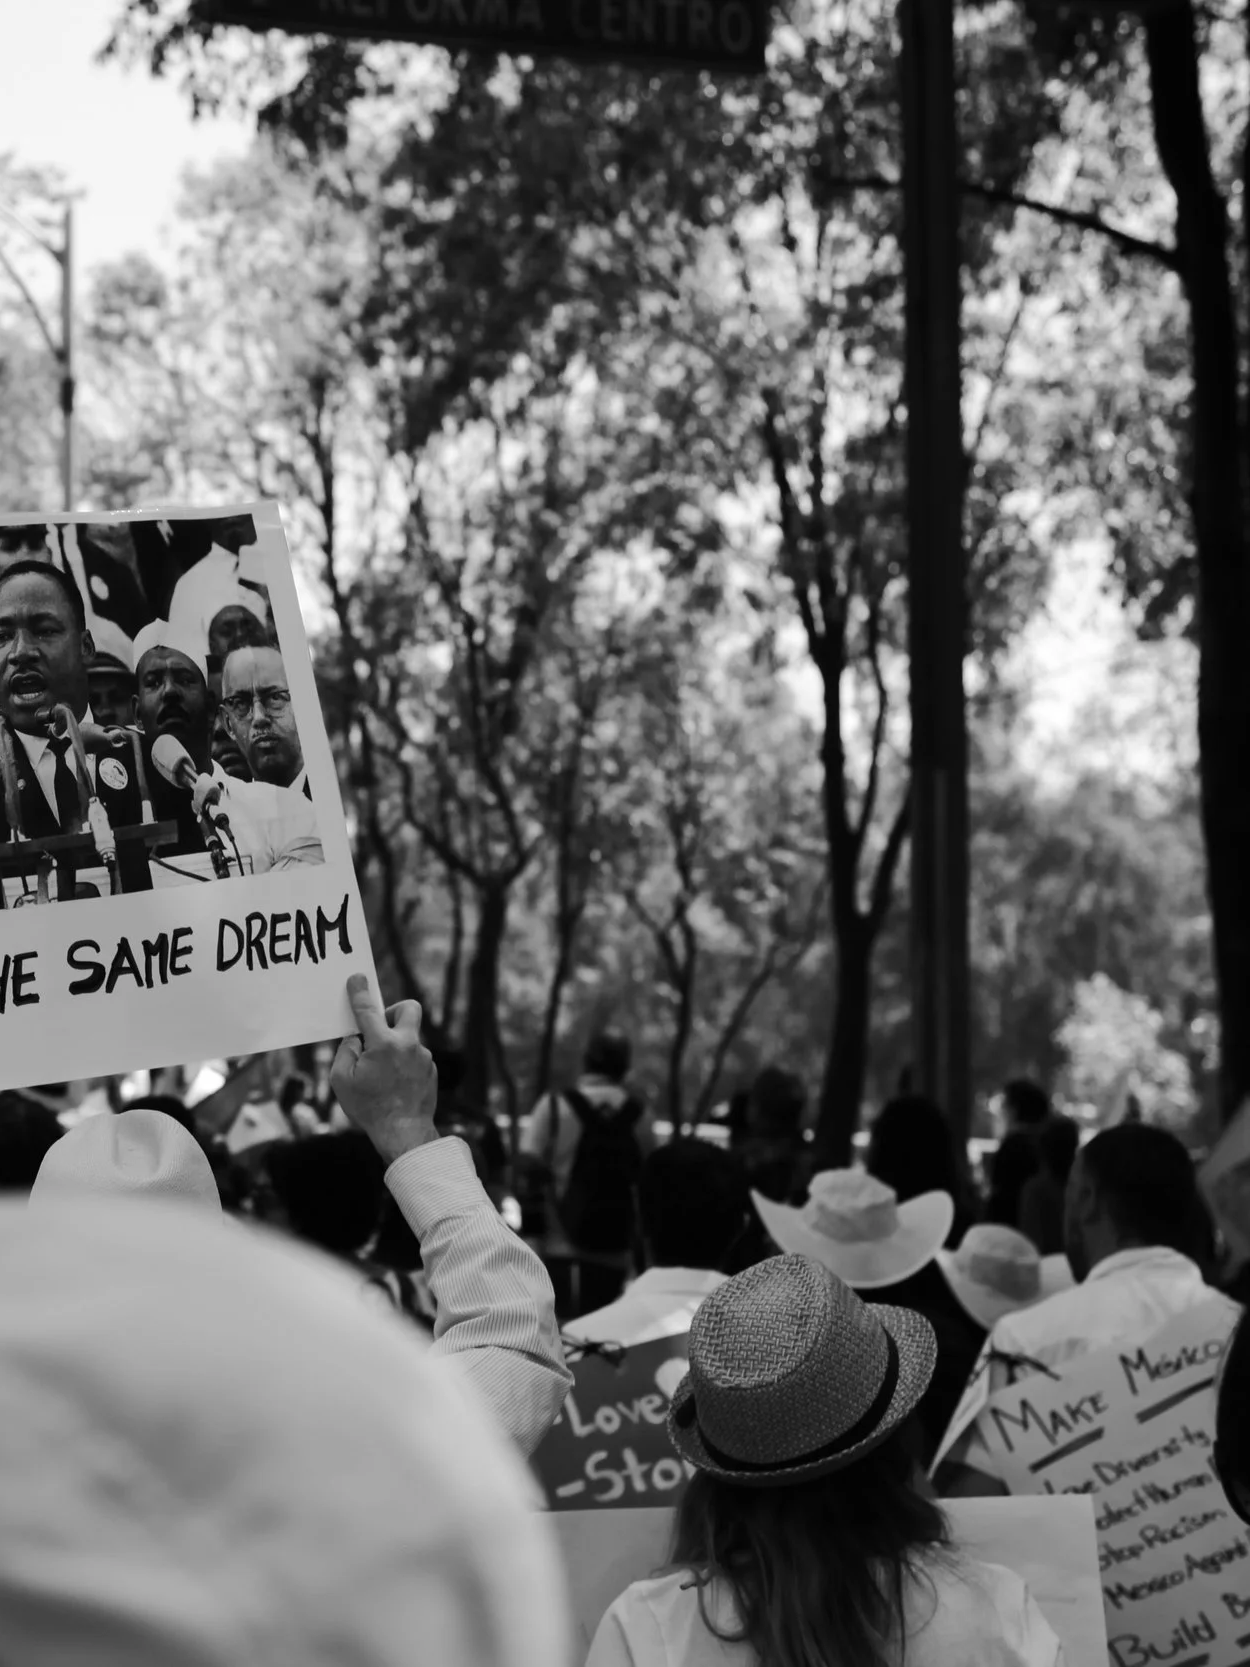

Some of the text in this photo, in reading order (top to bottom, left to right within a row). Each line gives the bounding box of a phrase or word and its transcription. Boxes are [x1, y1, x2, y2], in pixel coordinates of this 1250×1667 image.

[319, 0, 753, 54] ORMA CENTRO
[66, 926, 194, 996] SAME
[216, 893, 353, 972] DREAM
[564, 1392, 668, 1437] Love
[1107, 1610, 1217, 1667] Build
